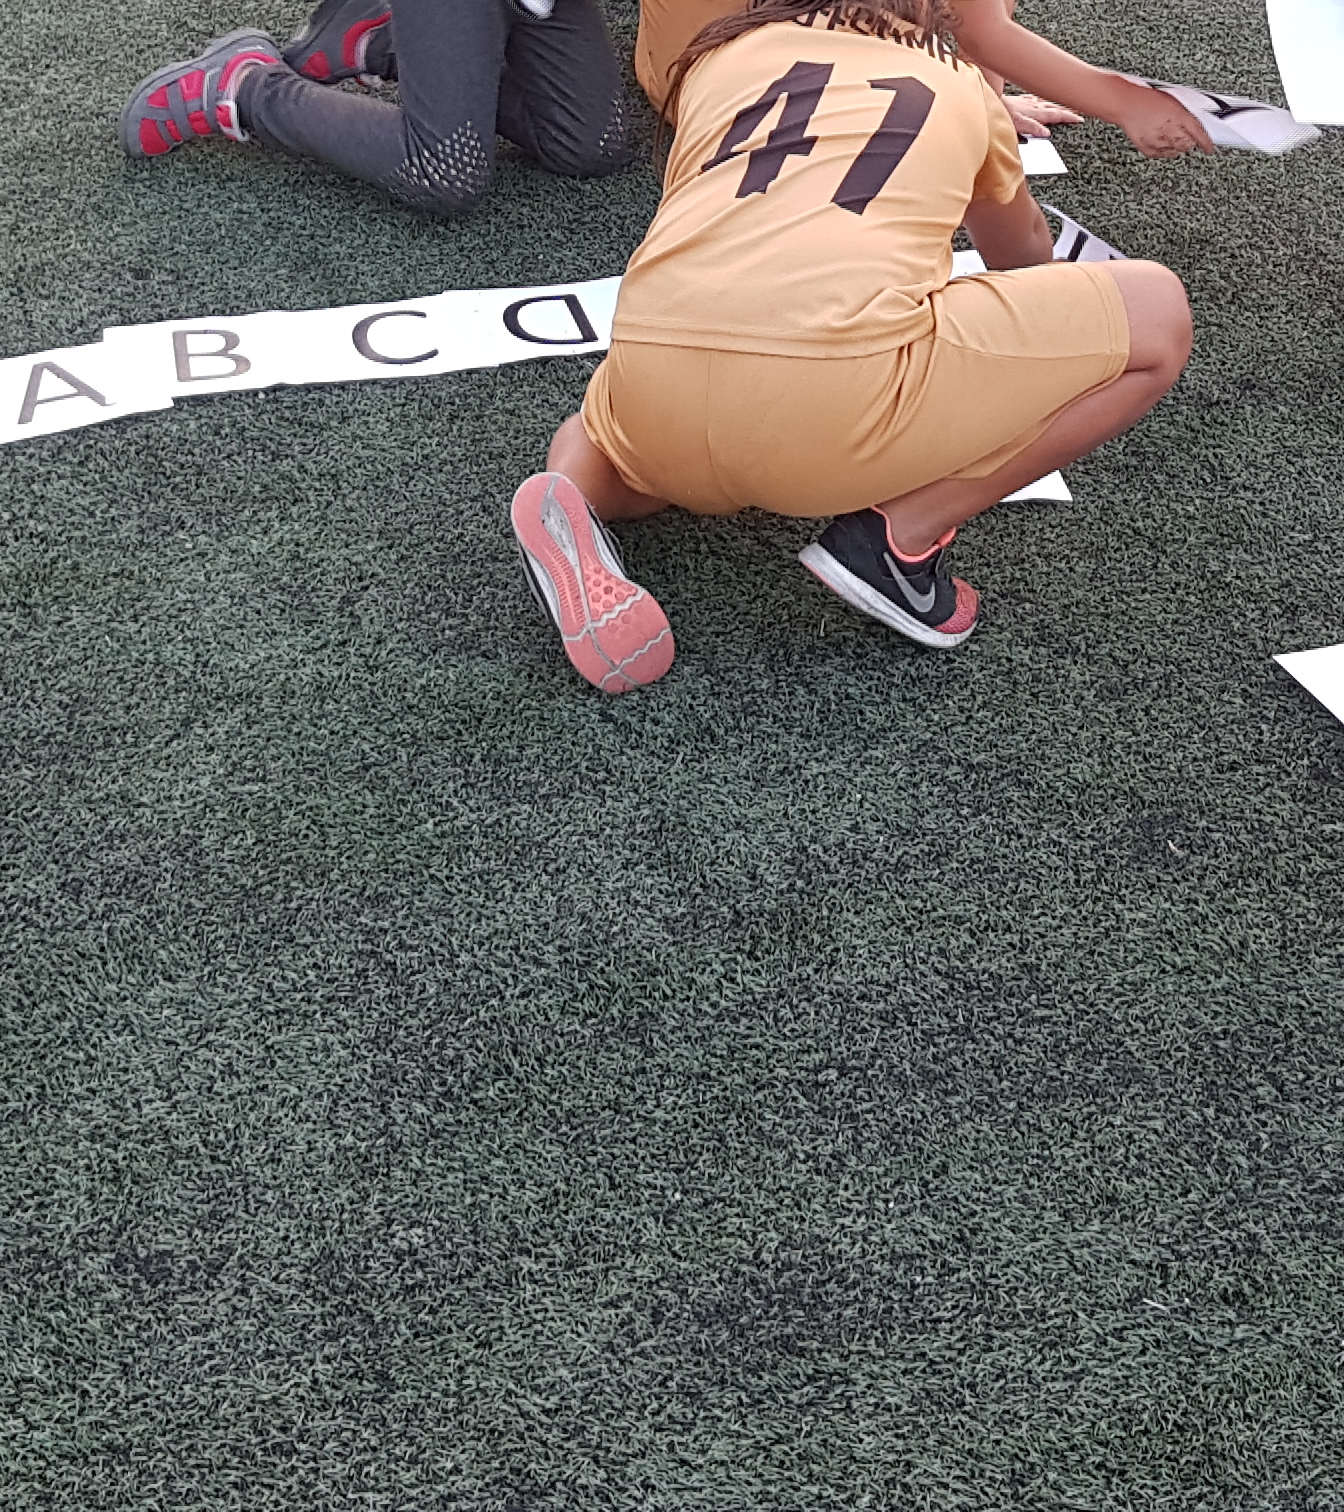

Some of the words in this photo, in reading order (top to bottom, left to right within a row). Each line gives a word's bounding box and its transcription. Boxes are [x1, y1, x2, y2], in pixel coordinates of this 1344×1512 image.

[17, 361, 113, 426] A
[171, 329, 252, 383] B
[351, 309, 440, 367] C
[502, 293, 599, 345] D
